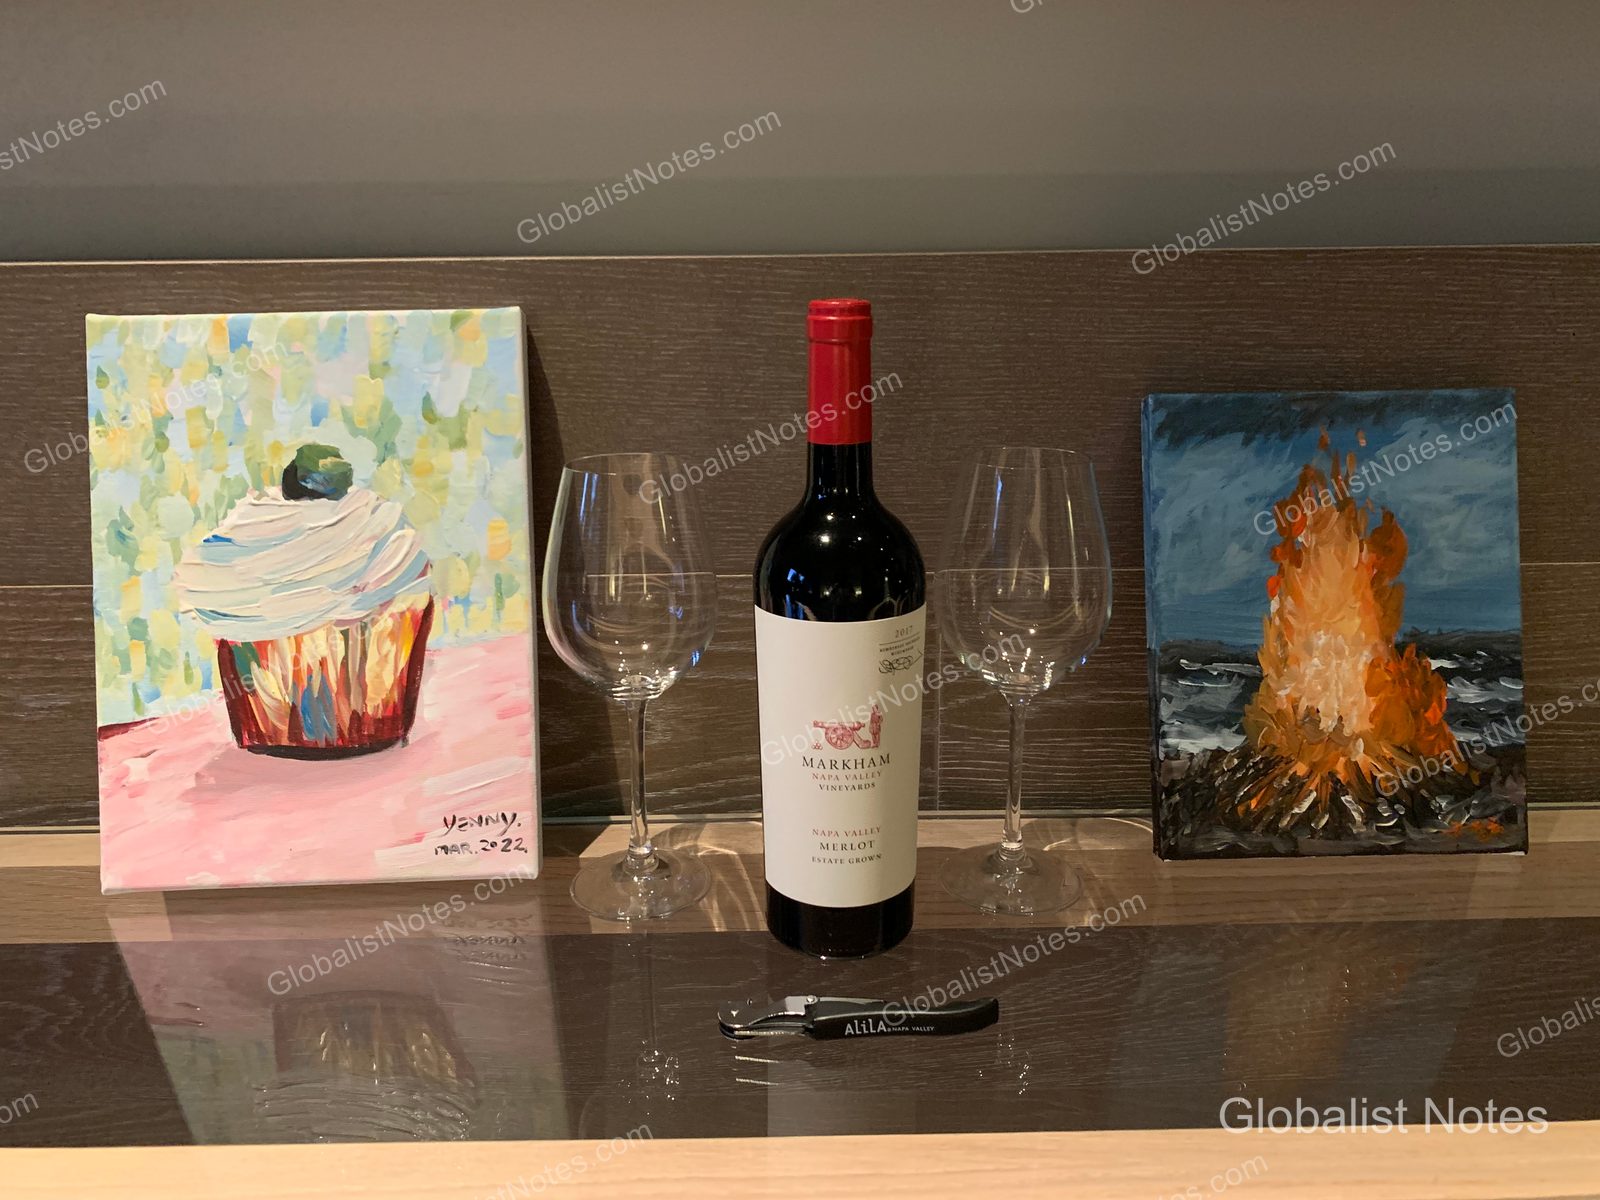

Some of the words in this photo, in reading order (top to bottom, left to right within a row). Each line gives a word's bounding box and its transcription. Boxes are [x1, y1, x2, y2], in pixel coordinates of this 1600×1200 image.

[895, 625, 913, 638] 2017
[802, 753, 890, 770] MARKHAM
[812, 773, 840, 781] NAPA
[845, 770, 882, 781] VALLEY
[819, 782, 876, 791] VINEYARDS
[812, 828, 840, 837] NAPA
[845, 826, 882, 837] VALLEY
[819, 840, 876, 851] MERLOT
[812, 856, 845, 865] ESTATE
[848, 853, 882, 865] GROWN
